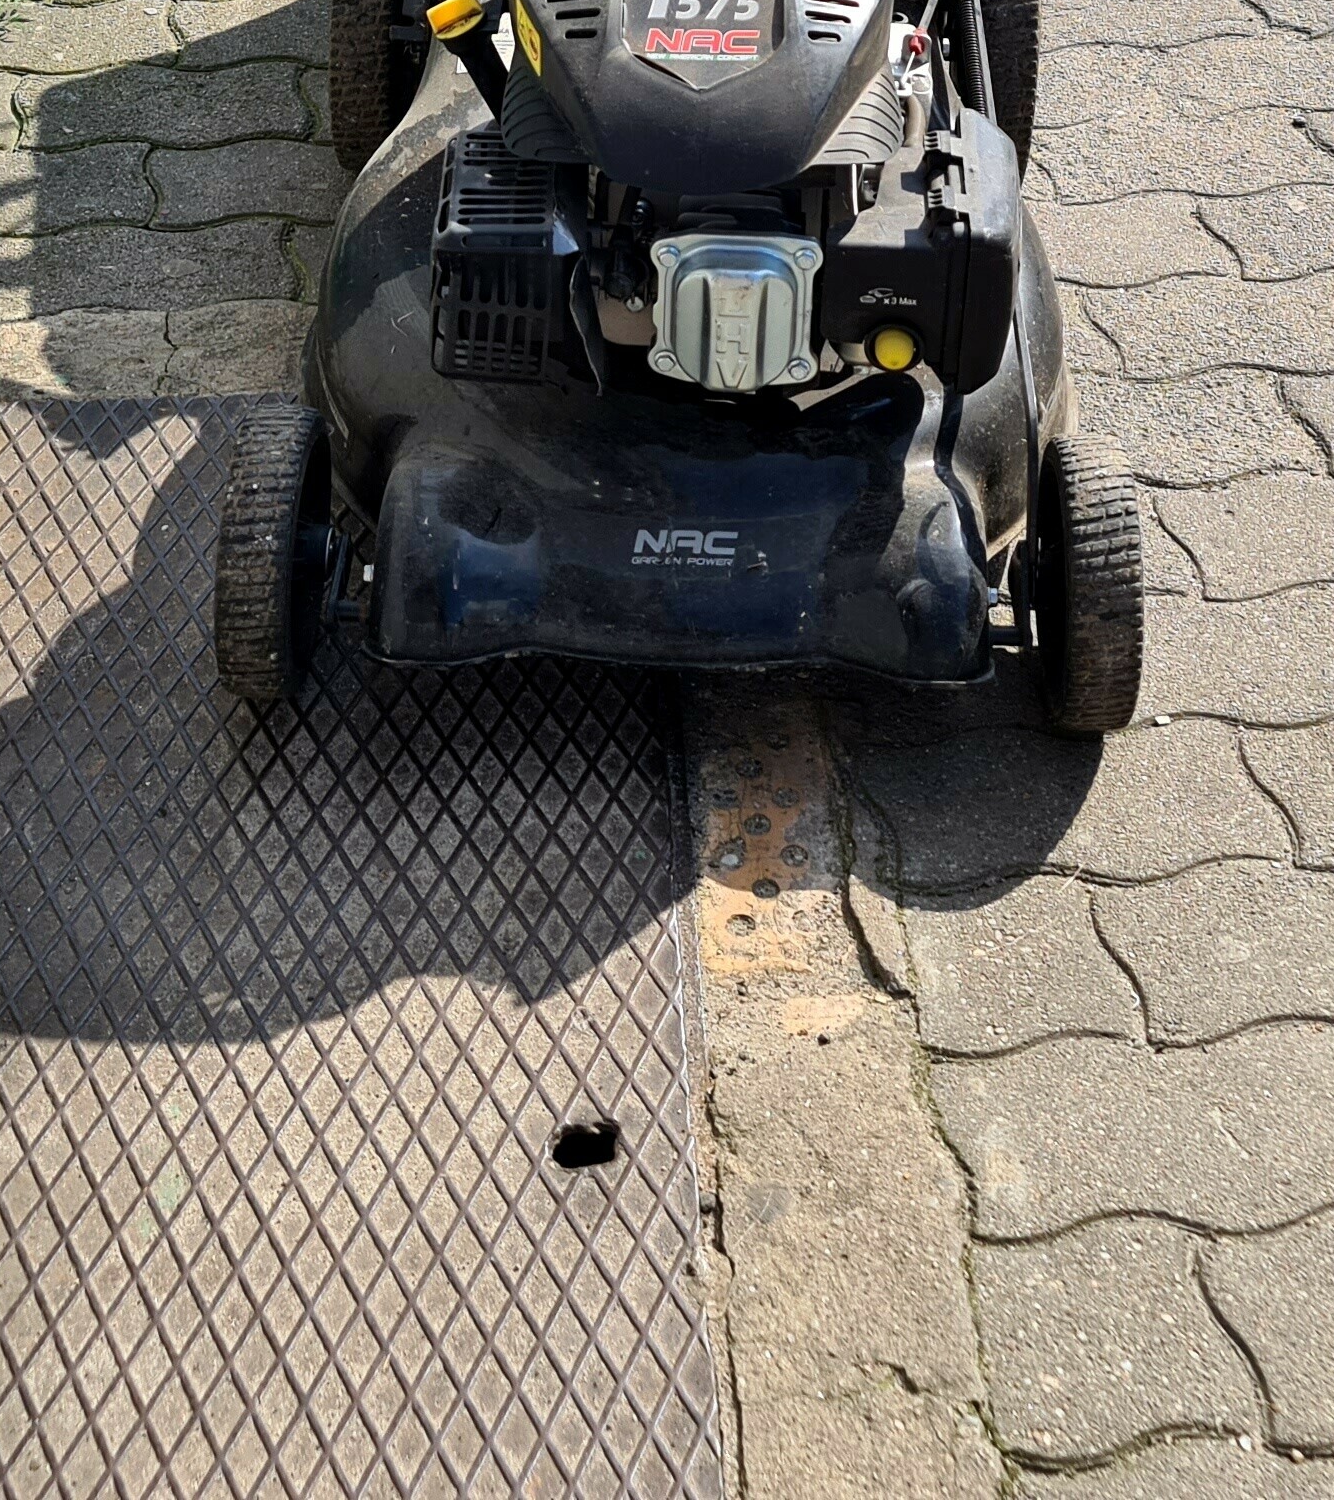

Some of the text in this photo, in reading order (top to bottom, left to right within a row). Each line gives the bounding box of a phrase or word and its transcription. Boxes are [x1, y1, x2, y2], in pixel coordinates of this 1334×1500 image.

[645, 28, 760, 54] NAC
[891, 297, 897, 305] 3
[899, 297, 917, 306] Max
[633, 529, 739, 556] NAC
[686, 557, 734, 567] POWER
